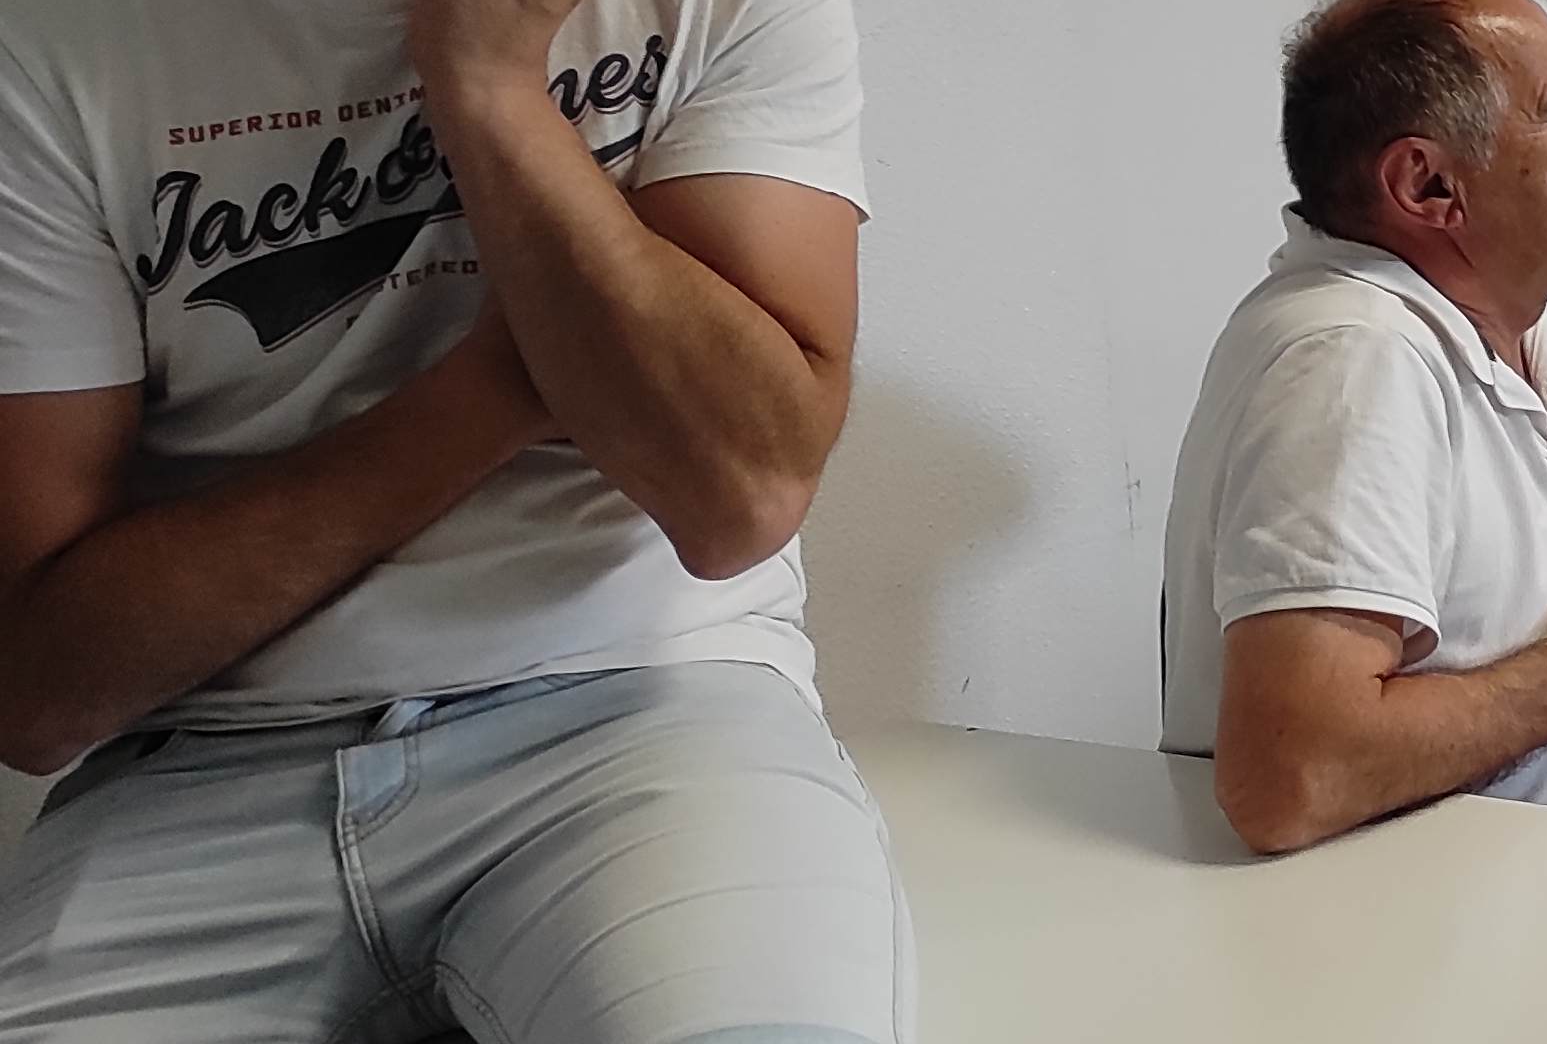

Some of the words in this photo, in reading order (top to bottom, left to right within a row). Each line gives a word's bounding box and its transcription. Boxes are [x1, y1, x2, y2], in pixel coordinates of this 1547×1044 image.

[168, 109, 322, 146] SUPERIOR
[337, 85, 426, 123] DENIM
[136, 137, 371, 296] Jack
